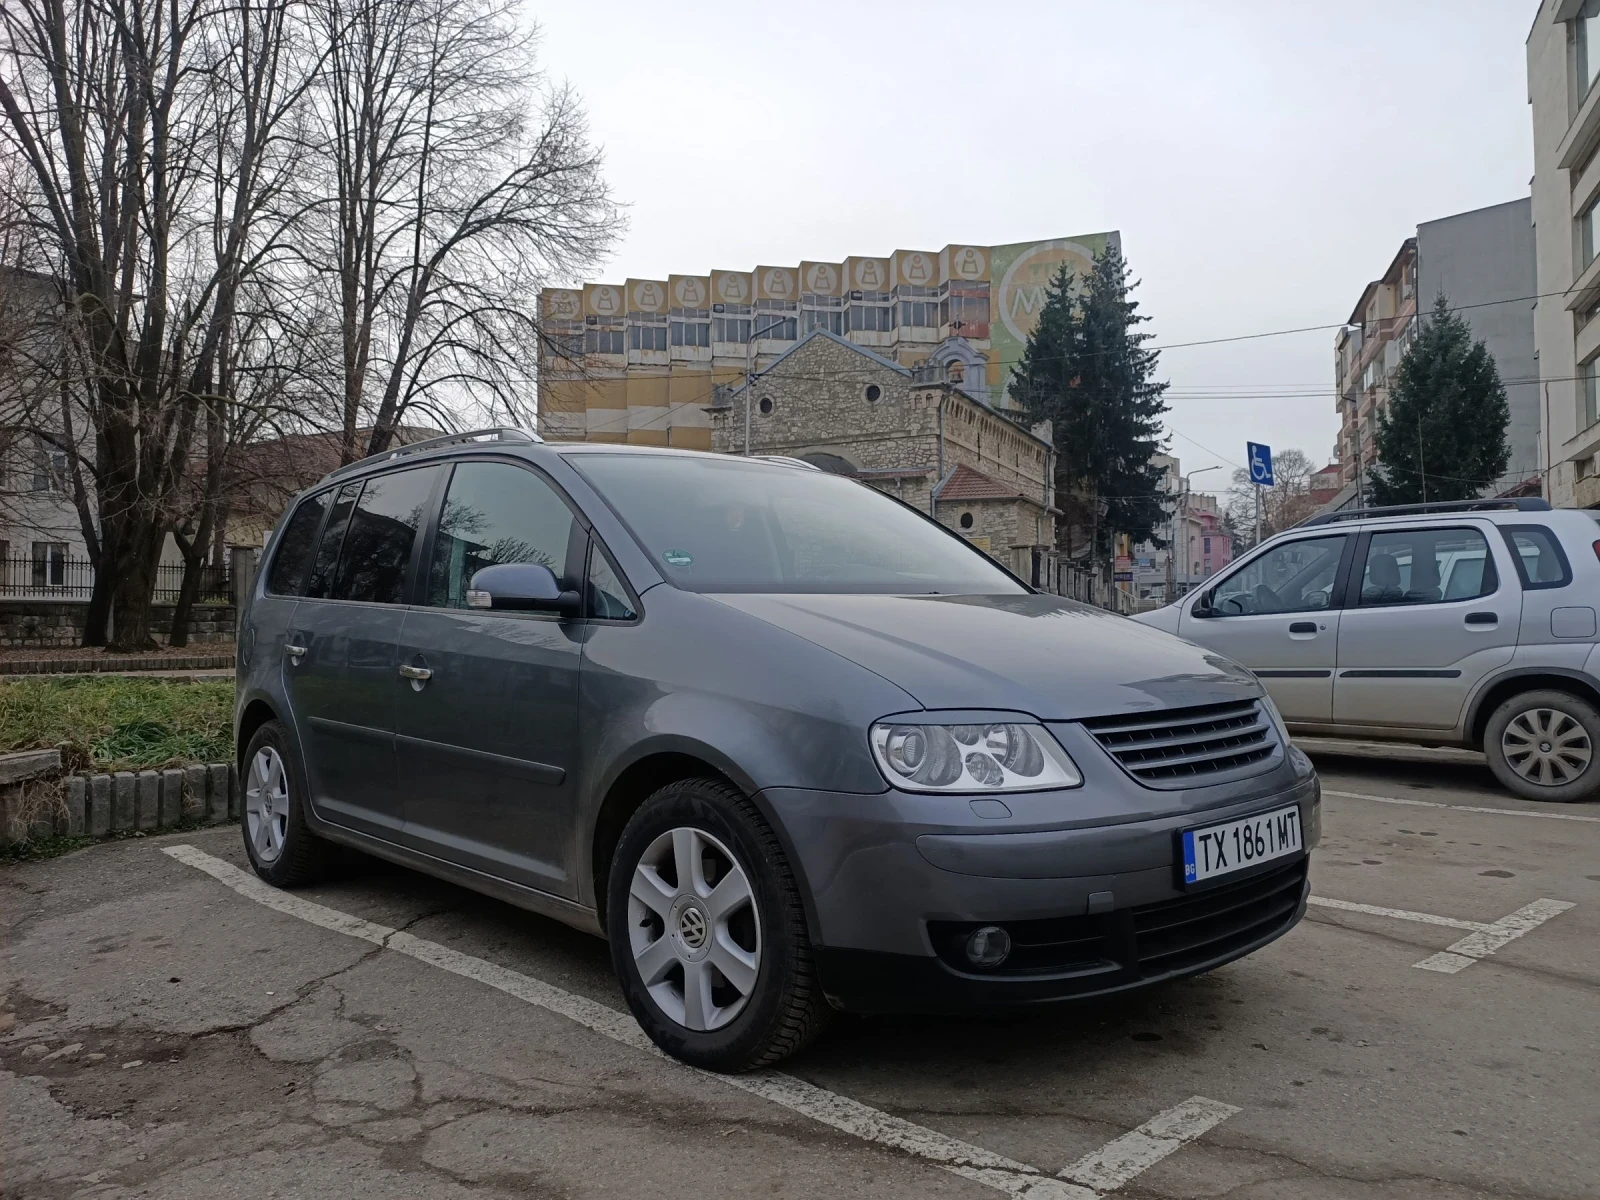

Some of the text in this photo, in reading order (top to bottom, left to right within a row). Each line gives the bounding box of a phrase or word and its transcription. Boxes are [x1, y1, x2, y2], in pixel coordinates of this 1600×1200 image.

[1199, 812, 1296, 872] TX 1861 MT
[1185, 864, 1195, 876] BG
